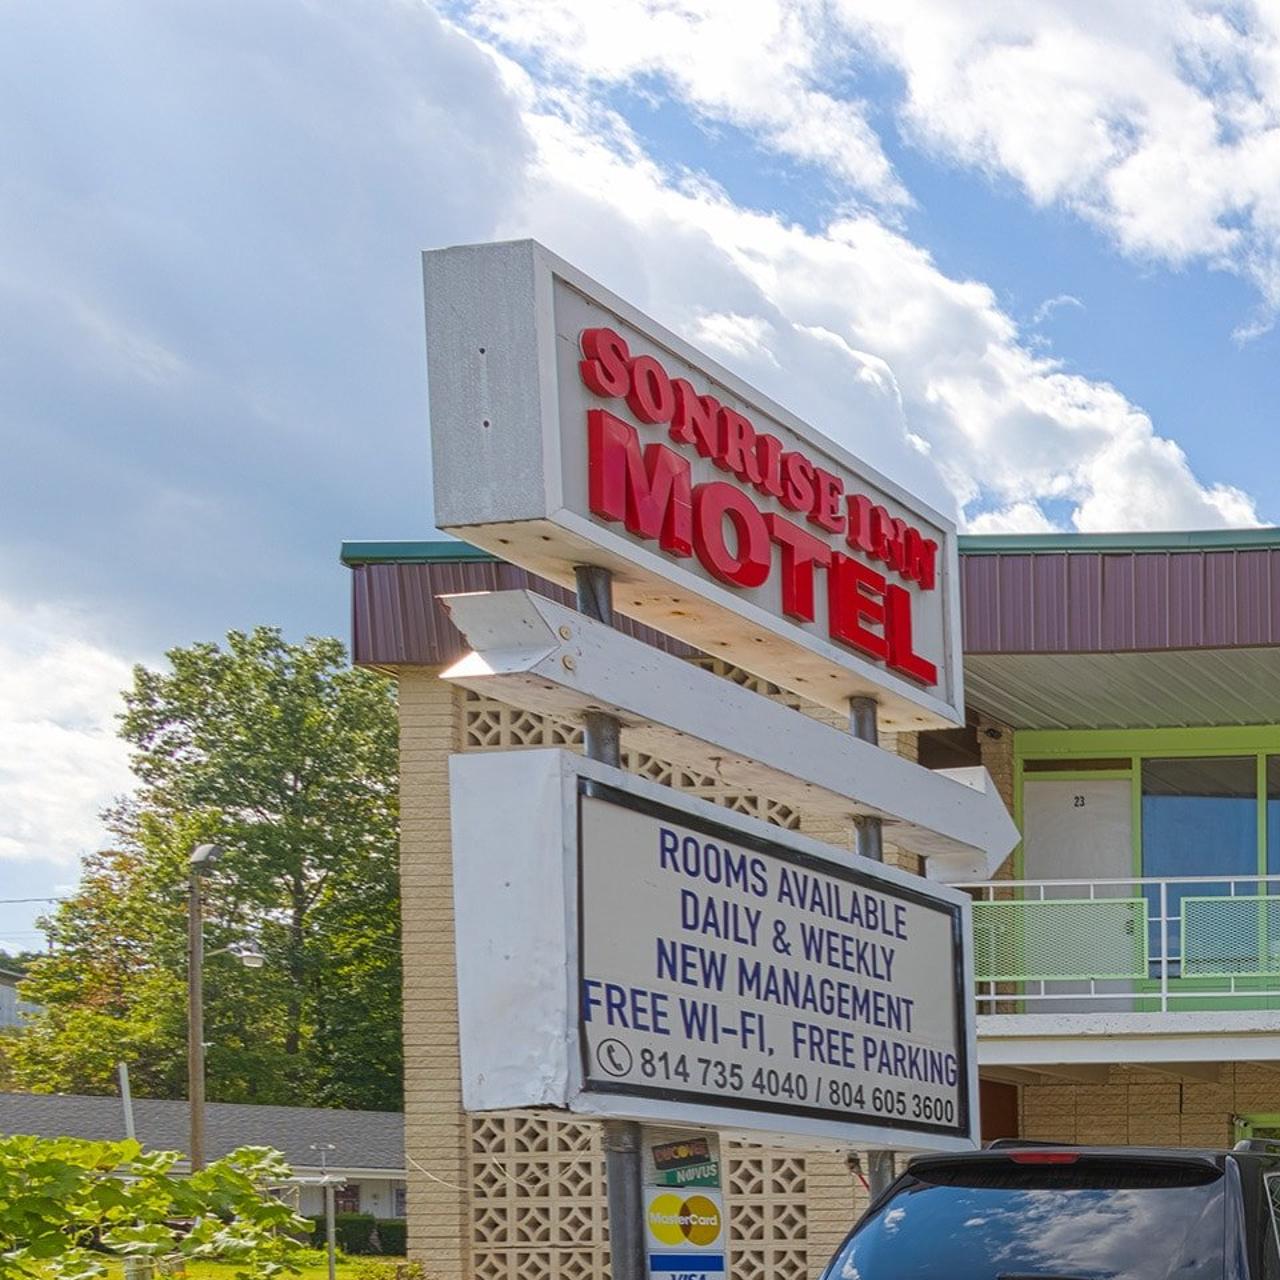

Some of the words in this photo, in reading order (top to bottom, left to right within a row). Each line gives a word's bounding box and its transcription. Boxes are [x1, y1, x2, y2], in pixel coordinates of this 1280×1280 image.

[579, 327, 846, 533] SONRISE
[846, 494, 938, 590] INN
[588, 409, 937, 686] MOTEL
[1074, 795, 1085, 807] 23
[660, 827, 768, 897] ROOMS
[777, 867, 908, 940] AVAILABLE
[681, 889, 762, 947] DAILY
[773, 919, 791, 955] &
[800, 922, 895, 981] WEEKLY
[583, 979, 670, 1035] FREE
[679, 998, 774, 1056] WI-FI,
[792, 1021, 856, 1069] FREE
[863, 1036, 958, 1087] PARKING
[656, 937, 727, 991] NEW
[738, 957, 914, 1033] MANAGEMENT
[640, 1048, 690, 1083] 814
[697, 1057, 743, 1091] 735
[752, 1067, 807, 1100] 4040
[829, 1079, 865, 1109] 804
[872, 1086, 906, 1116] 605
[912, 1094, 953, 1122] 3600
[676, 1163, 718, 1183] NOVUS
